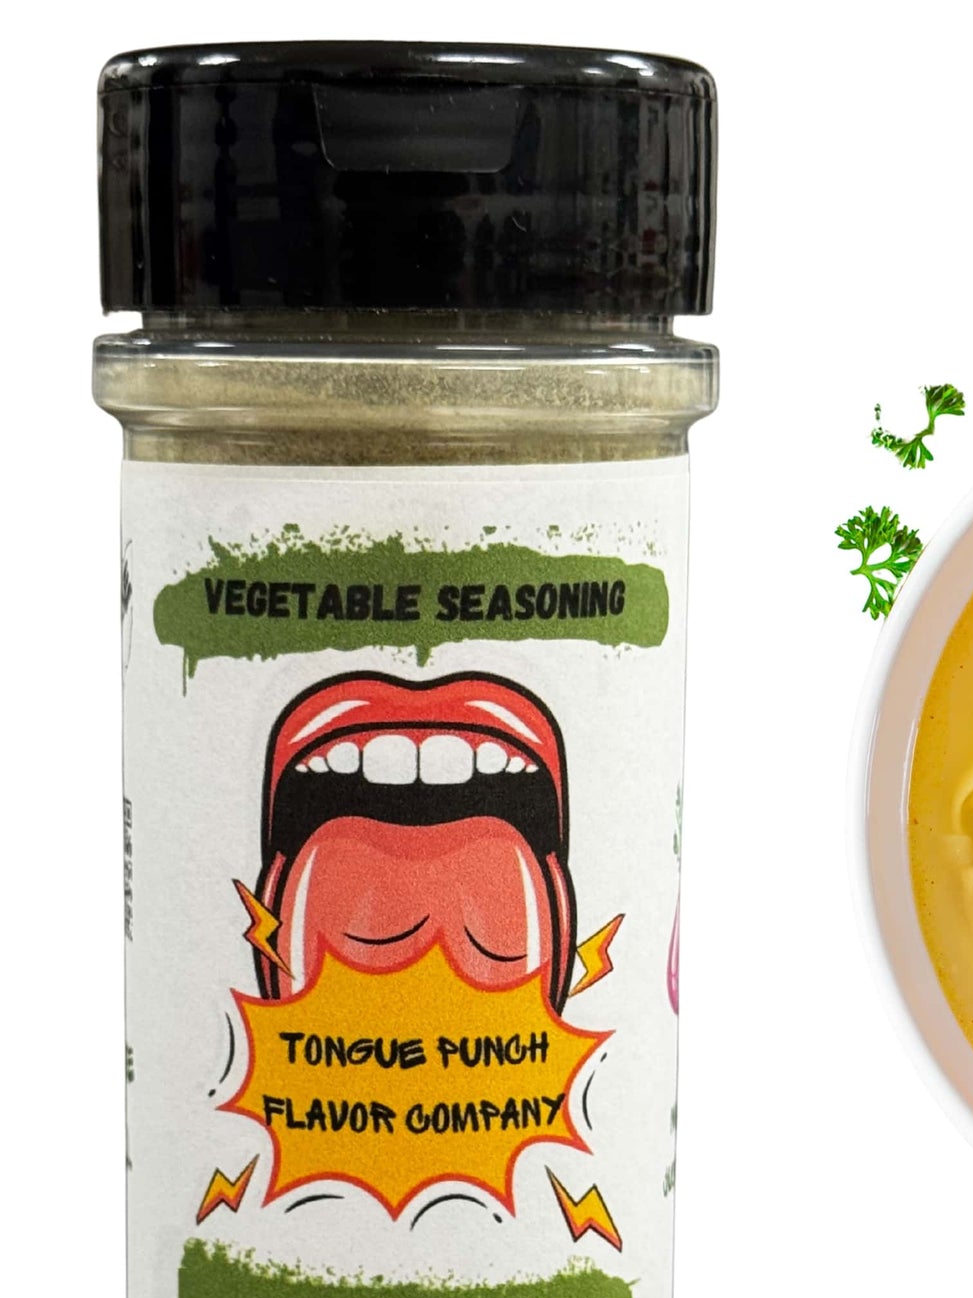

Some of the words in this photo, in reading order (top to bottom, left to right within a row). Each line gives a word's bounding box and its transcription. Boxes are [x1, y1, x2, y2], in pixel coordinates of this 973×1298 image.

[204, 578, 422, 622] VEGETABLE
[435, 579, 627, 622] SEASONING
[278, 1031, 427, 1069] TONGUE
[436, 1031, 550, 1069] PUNCH
[262, 1094, 397, 1134] FLAVOR
[404, 1092, 566, 1134] COMPANY
